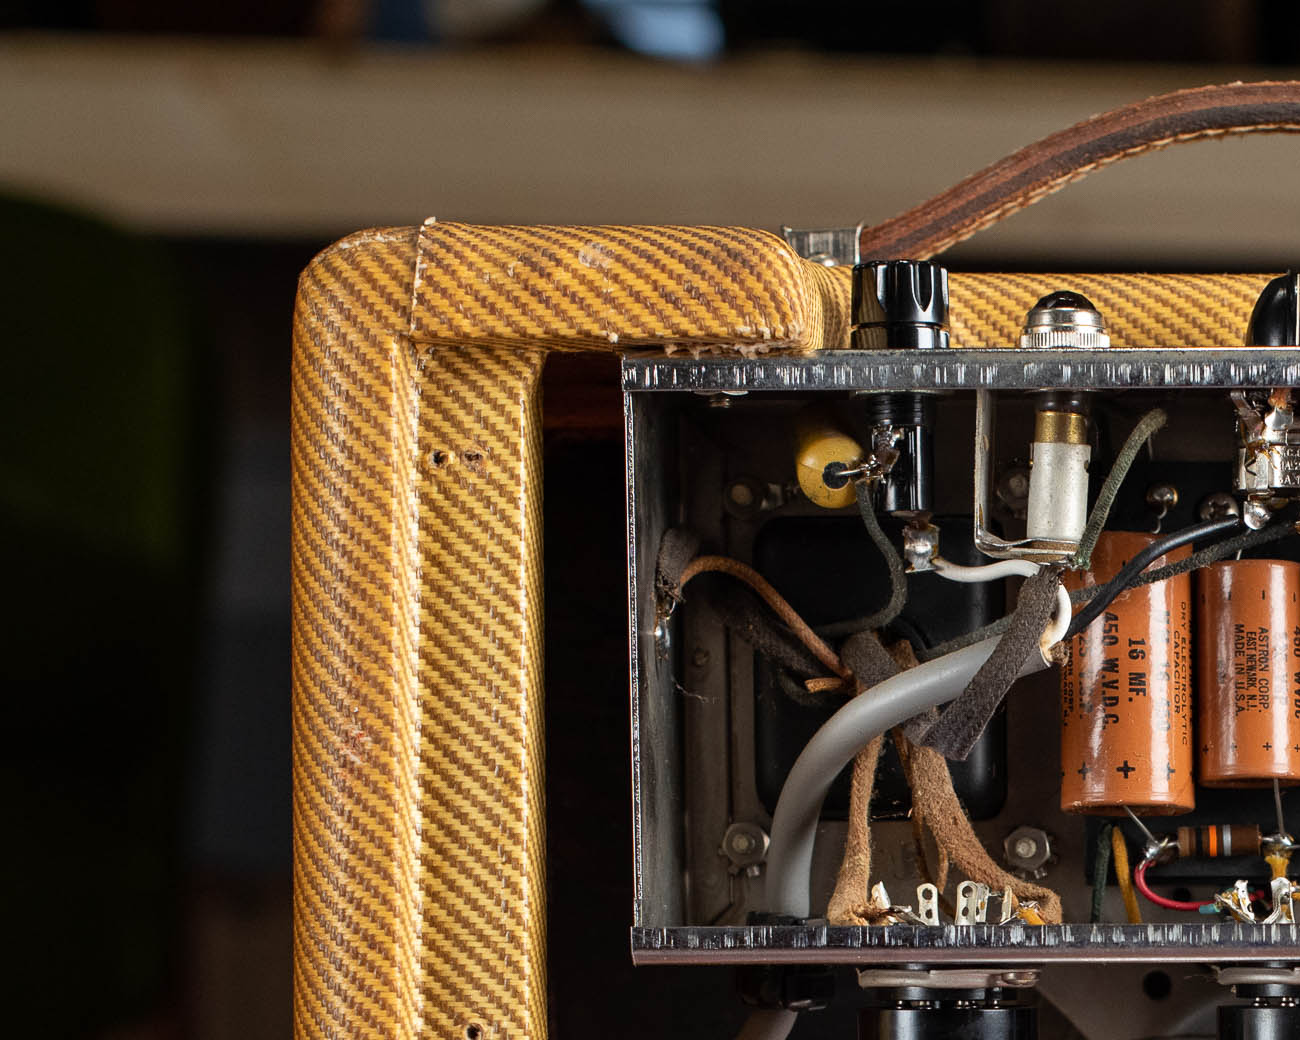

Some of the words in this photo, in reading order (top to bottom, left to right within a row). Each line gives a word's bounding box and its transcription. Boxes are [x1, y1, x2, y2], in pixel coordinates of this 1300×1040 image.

[1102, 612, 1119, 646] 450
[1234, 624, 1246, 657] MADE
[1246, 631, 1257, 651] EAST
[1128, 638, 1147, 660] 16
[1258, 627, 1270, 672] ASTRON
[1174, 631, 1182, 715] CAPACITOR
[1234, 663, 1246, 675] IN
[1245, 654, 1257, 691] NEWARK,
[1128, 672, 1147, 703] MF.
[1234, 681, 1246, 717] U.S.A.
[1258, 678, 1270, 713] CORP.
